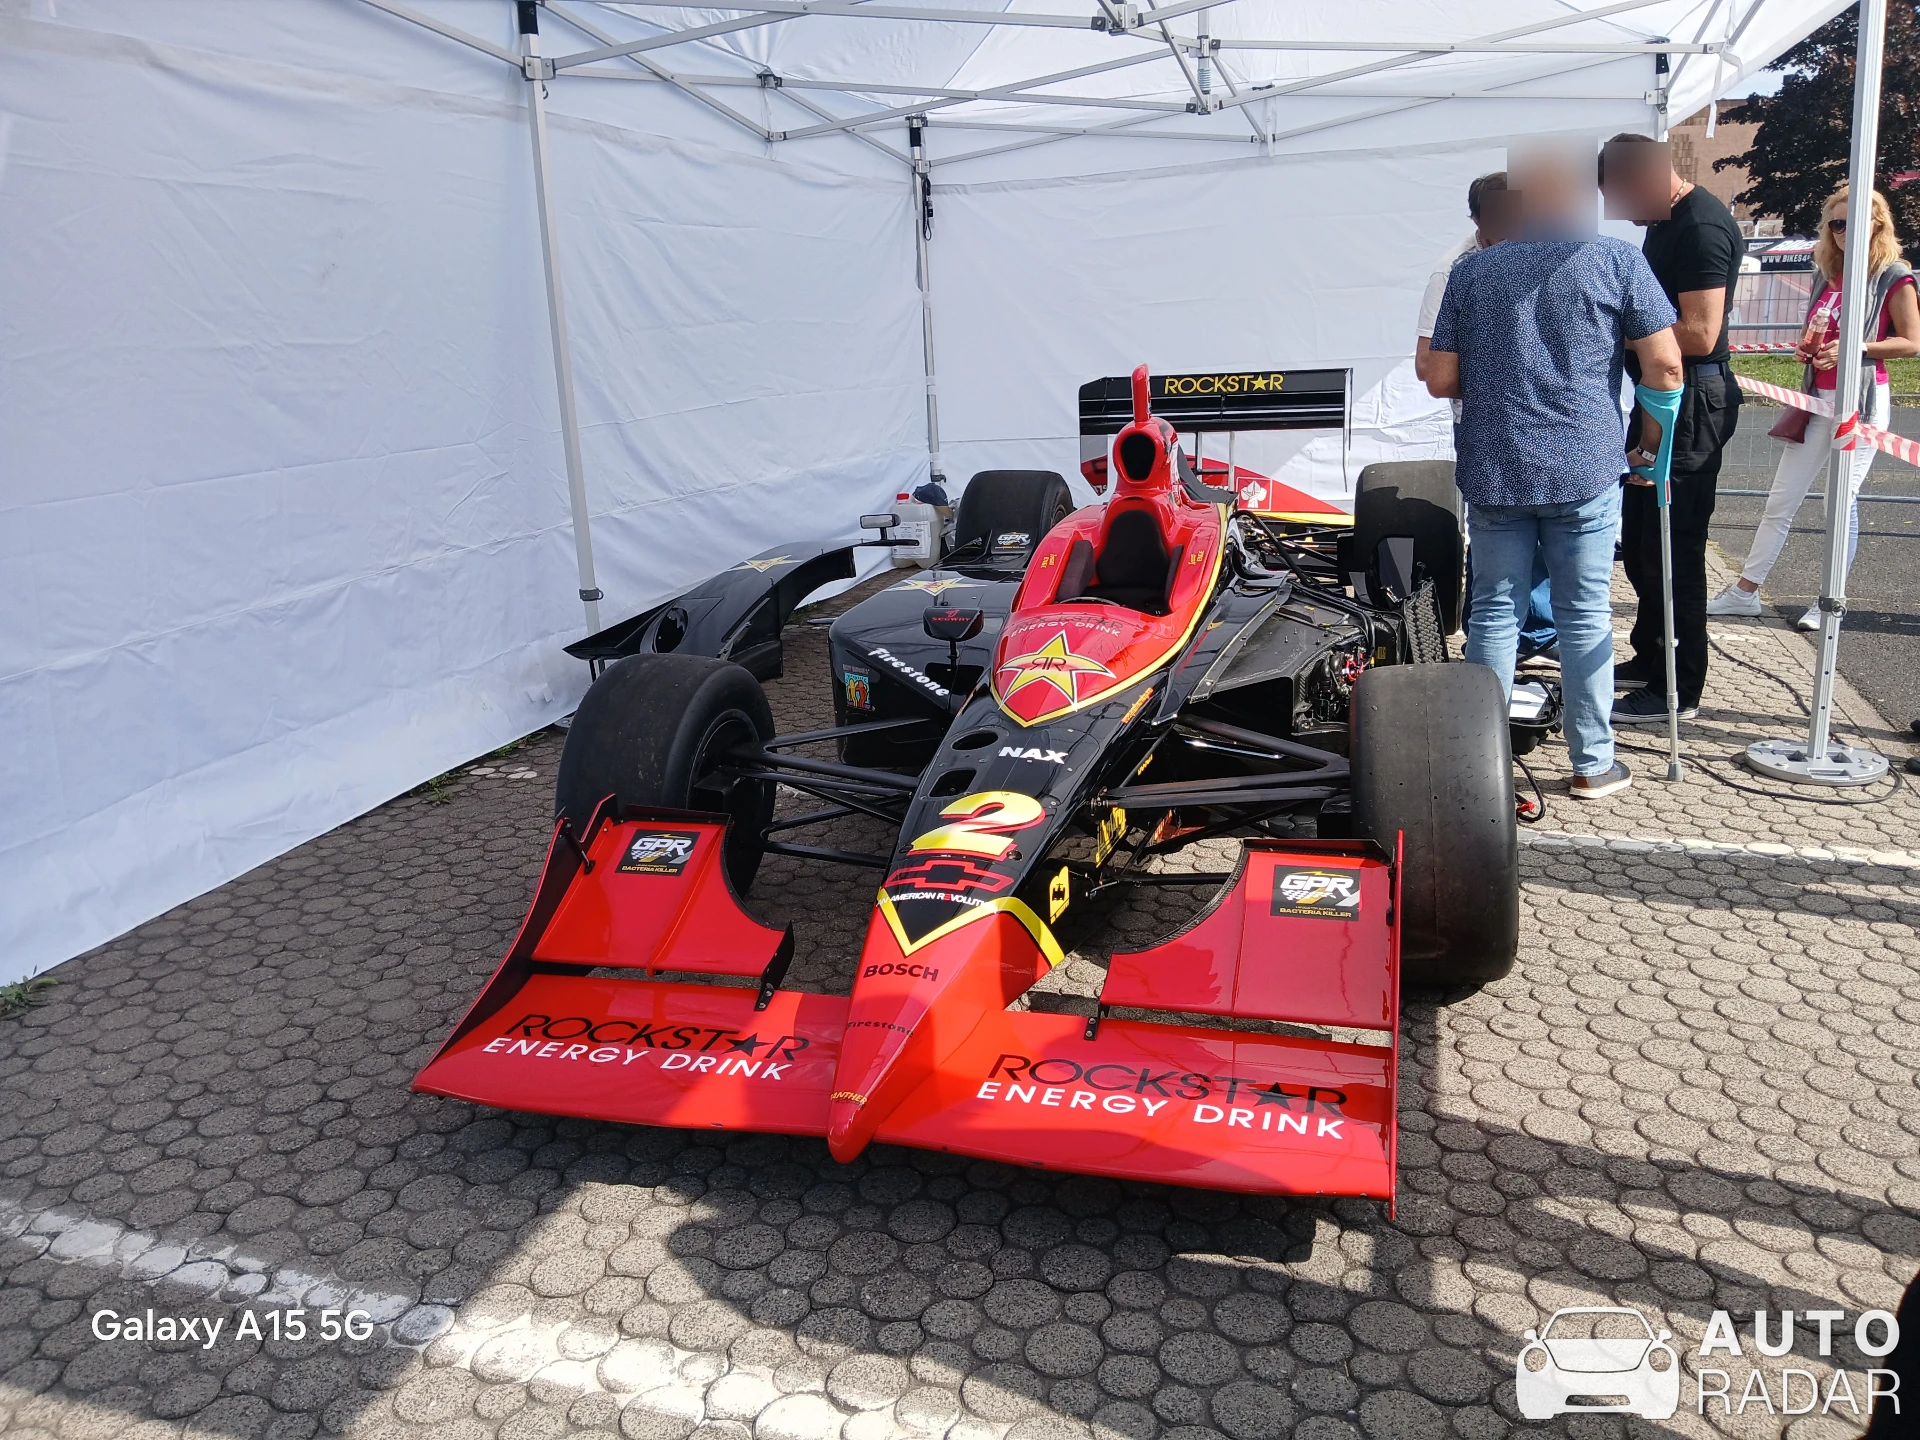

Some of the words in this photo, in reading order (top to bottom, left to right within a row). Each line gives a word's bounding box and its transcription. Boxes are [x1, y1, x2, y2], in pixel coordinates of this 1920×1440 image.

[997, 534, 1029, 542] GPR
[1011, 621, 1068, 637] ENERGY
[1075, 621, 1121, 637] DRINK
[868, 647, 950, 696] Firestone
[998, 746, 1069, 764] NAX
[906, 790, 1047, 862] 2
[631, 837, 692, 856] GPR
[1280, 874, 1354, 898] GPR
[890, 892, 936, 902] AMERICAN
[1279, 907, 1321, 915] BACTERIA
[1322, 910, 1352, 918] KILLER
[863, 963, 939, 982] BOSCH
[482, 1037, 649, 1066] ENERGY
[659, 1053, 793, 1081] DRINK
[976, 1081, 1169, 1117] ENERGY
[1193, 1104, 1345, 1141] DRINK
